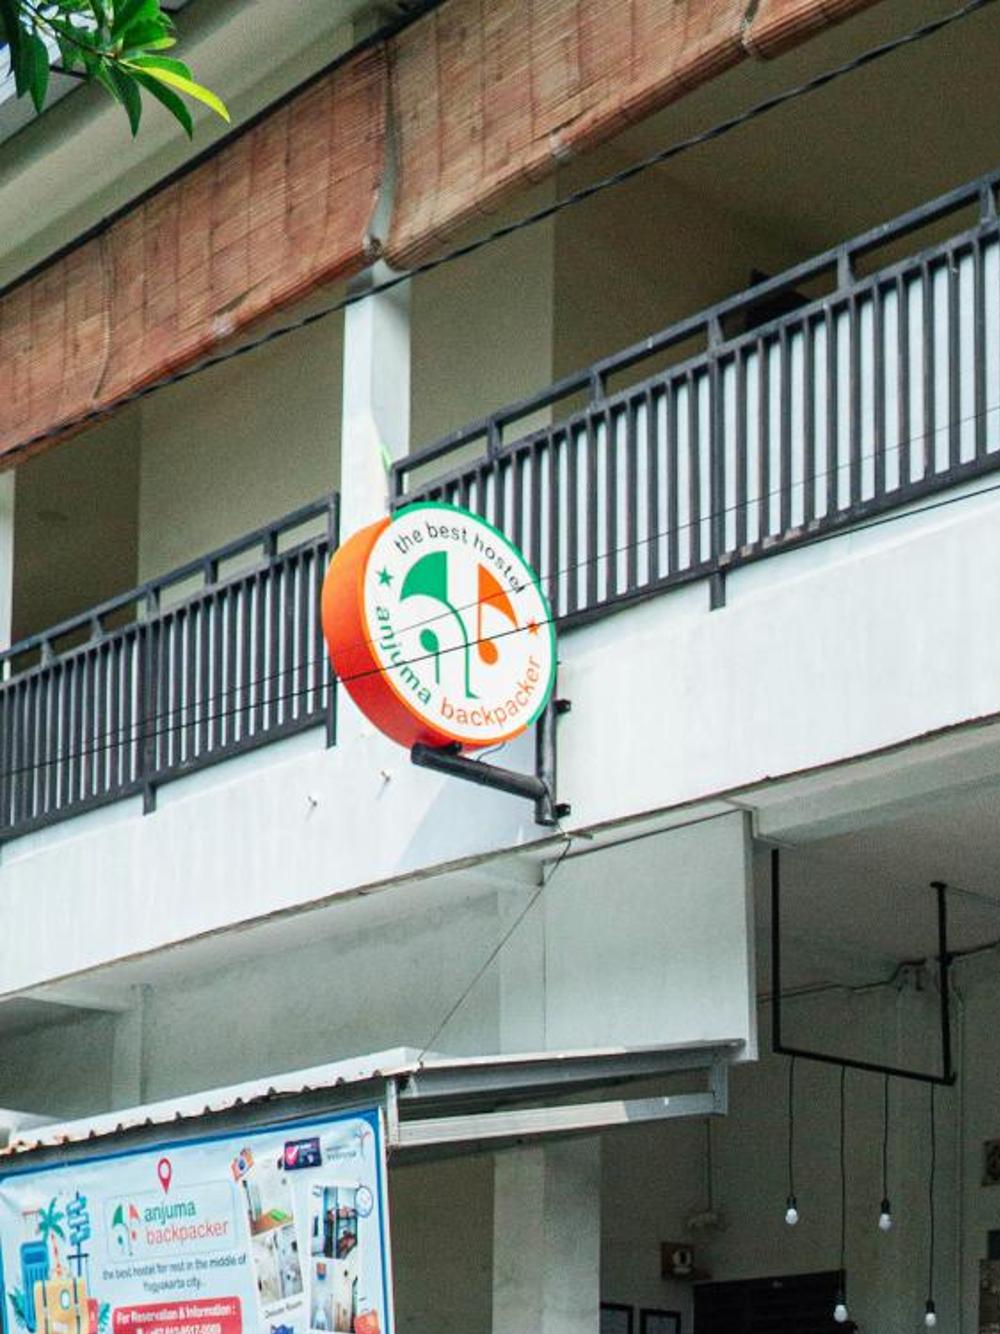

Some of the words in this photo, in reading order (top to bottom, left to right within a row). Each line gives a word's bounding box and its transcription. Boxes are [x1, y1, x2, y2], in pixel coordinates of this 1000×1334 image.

[394, 529, 422, 555] the
[427, 522, 468, 544] best
[473, 534, 527, 595] hostel
[376, 605, 433, 705] anjuma
[440, 655, 542, 727] backpacker
[144, 1201, 197, 1225] anjuma
[146, 1221, 229, 1245] backpacker
[209, 1254, 236, 1268] middle
[116, 1311, 131, 1325] For
[131, 1308, 179, 1324] Reservation
[186, 1304, 231, 1319] Information
